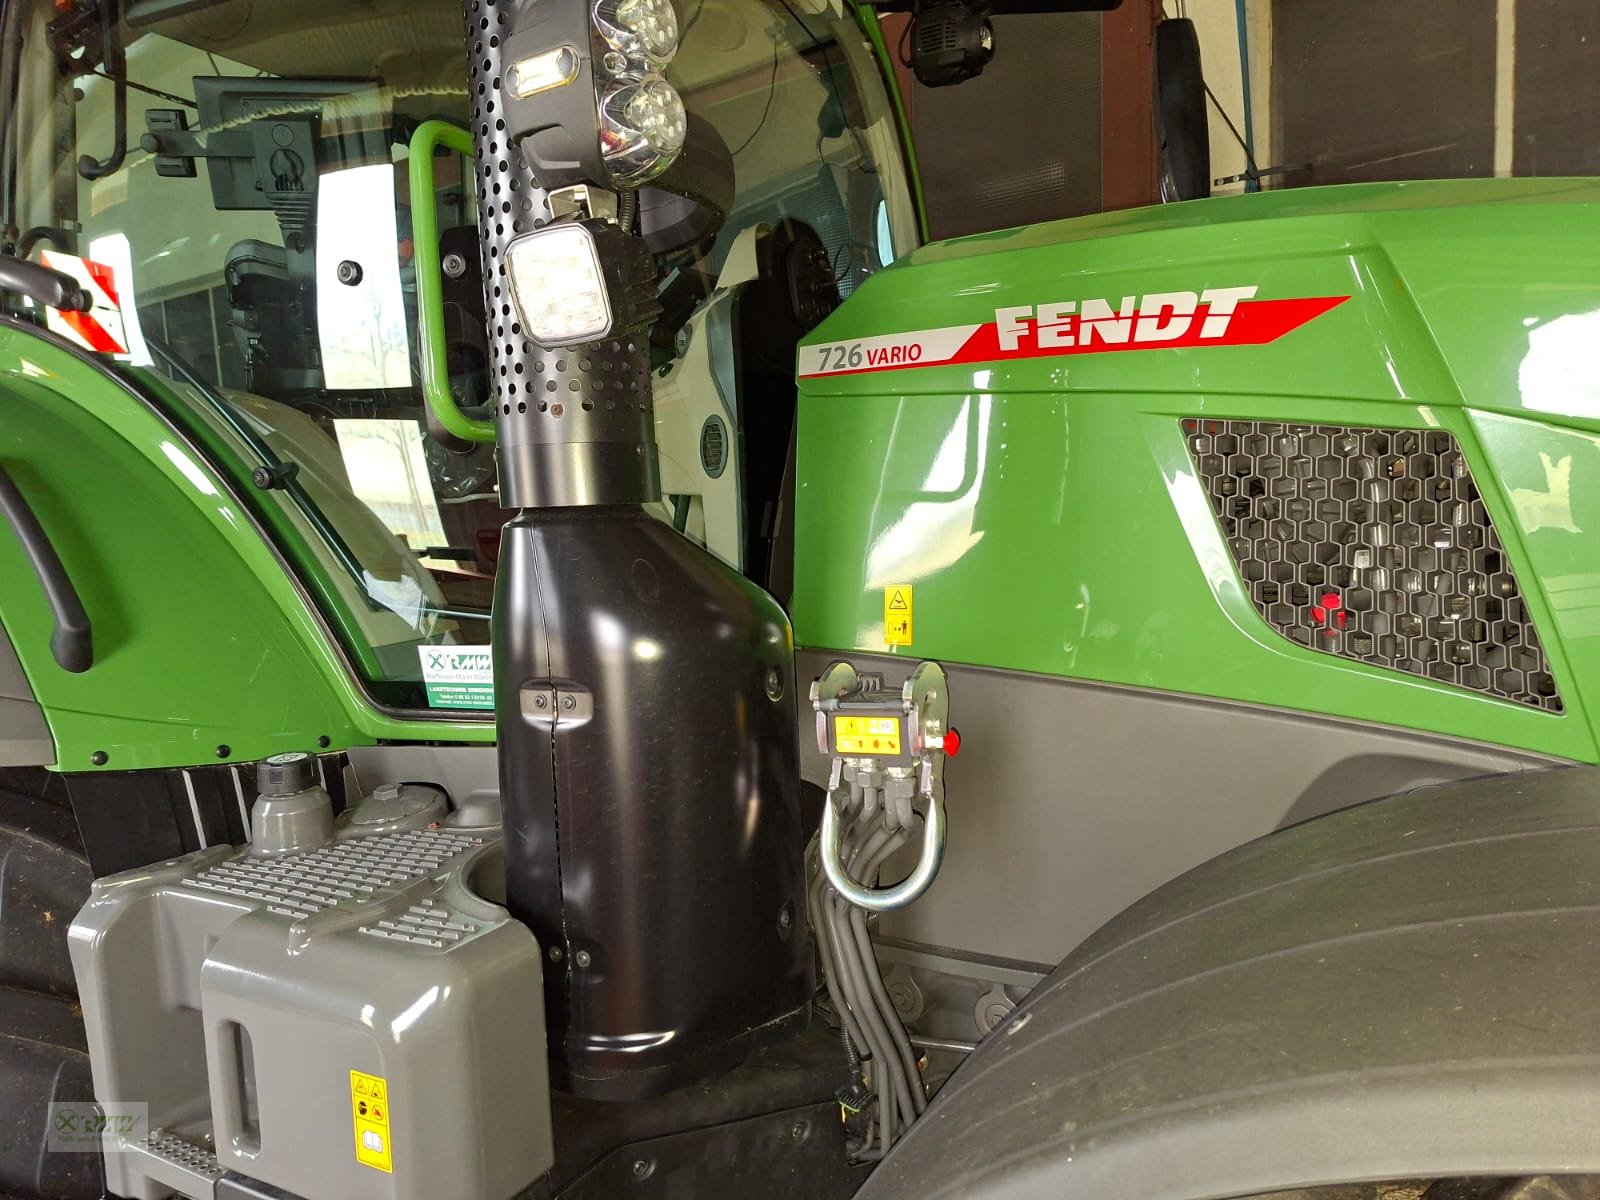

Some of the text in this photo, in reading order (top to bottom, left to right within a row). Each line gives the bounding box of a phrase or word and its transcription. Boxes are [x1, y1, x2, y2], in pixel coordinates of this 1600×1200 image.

[995, 285, 1259, 351] FENDT
[818, 343, 922, 371] 726 VARIO
